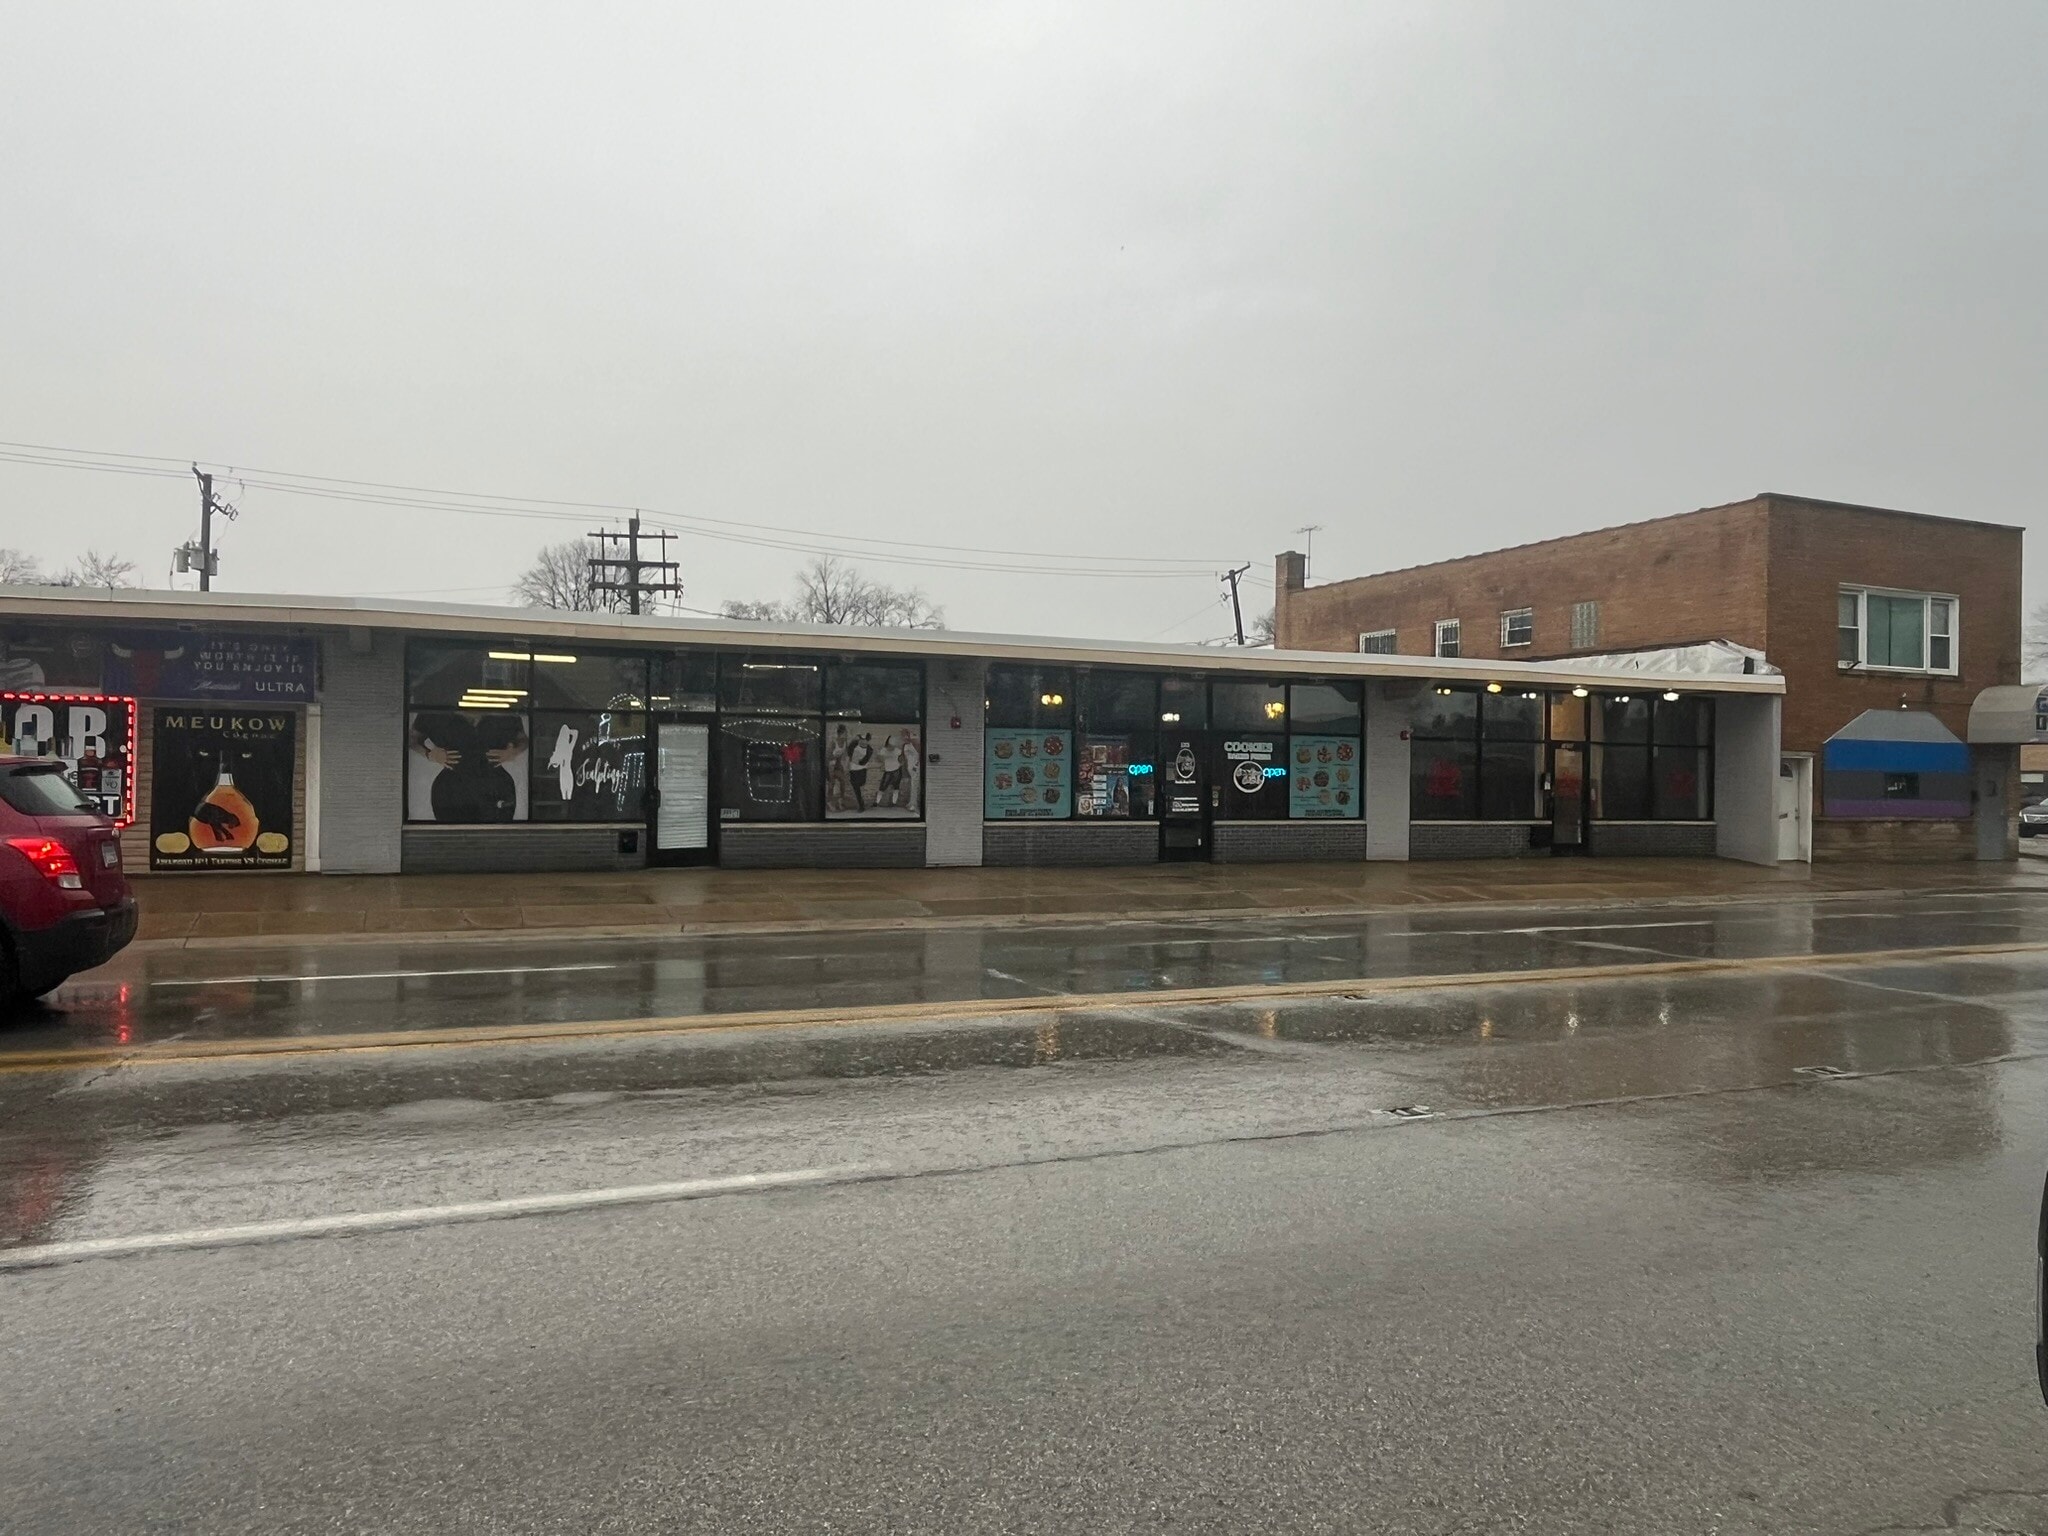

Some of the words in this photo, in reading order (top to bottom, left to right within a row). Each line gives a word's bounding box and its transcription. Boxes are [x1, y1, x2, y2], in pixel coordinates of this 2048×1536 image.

[194, 661, 224, 671] YOU
[255, 681, 305, 693] ULTRA
[165, 715, 286, 731] MEUKOW
[1129, 764, 1153, 776] open
[1262, 767, 1286, 778] open
